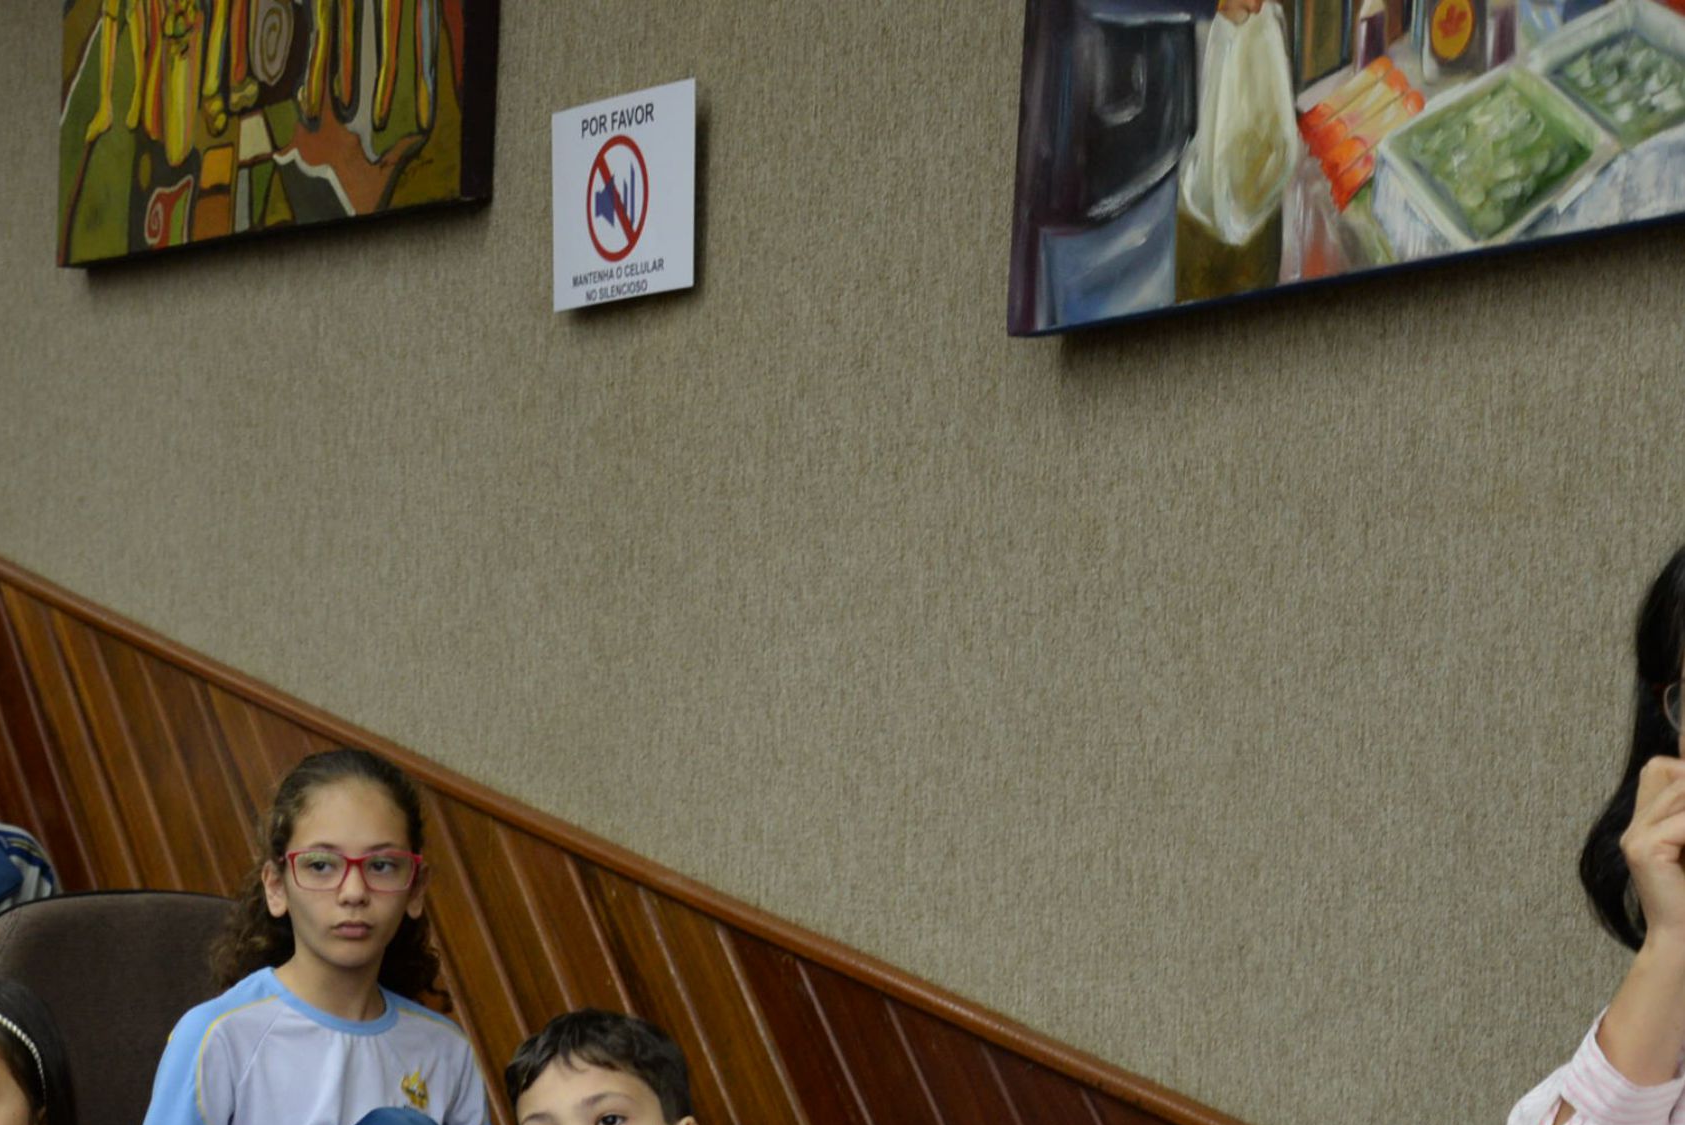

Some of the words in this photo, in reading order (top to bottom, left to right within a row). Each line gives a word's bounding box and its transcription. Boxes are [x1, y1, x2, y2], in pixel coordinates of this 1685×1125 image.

[581, 114, 607, 139] POR
[610, 102, 655, 131] FAVOR
[572, 268, 614, 288] MANTENHA
[616, 266, 623, 279] O
[624, 258, 664, 278] CELULAR
[586, 289, 597, 302] NO
[599, 279, 648, 300] SILENCIOSO
